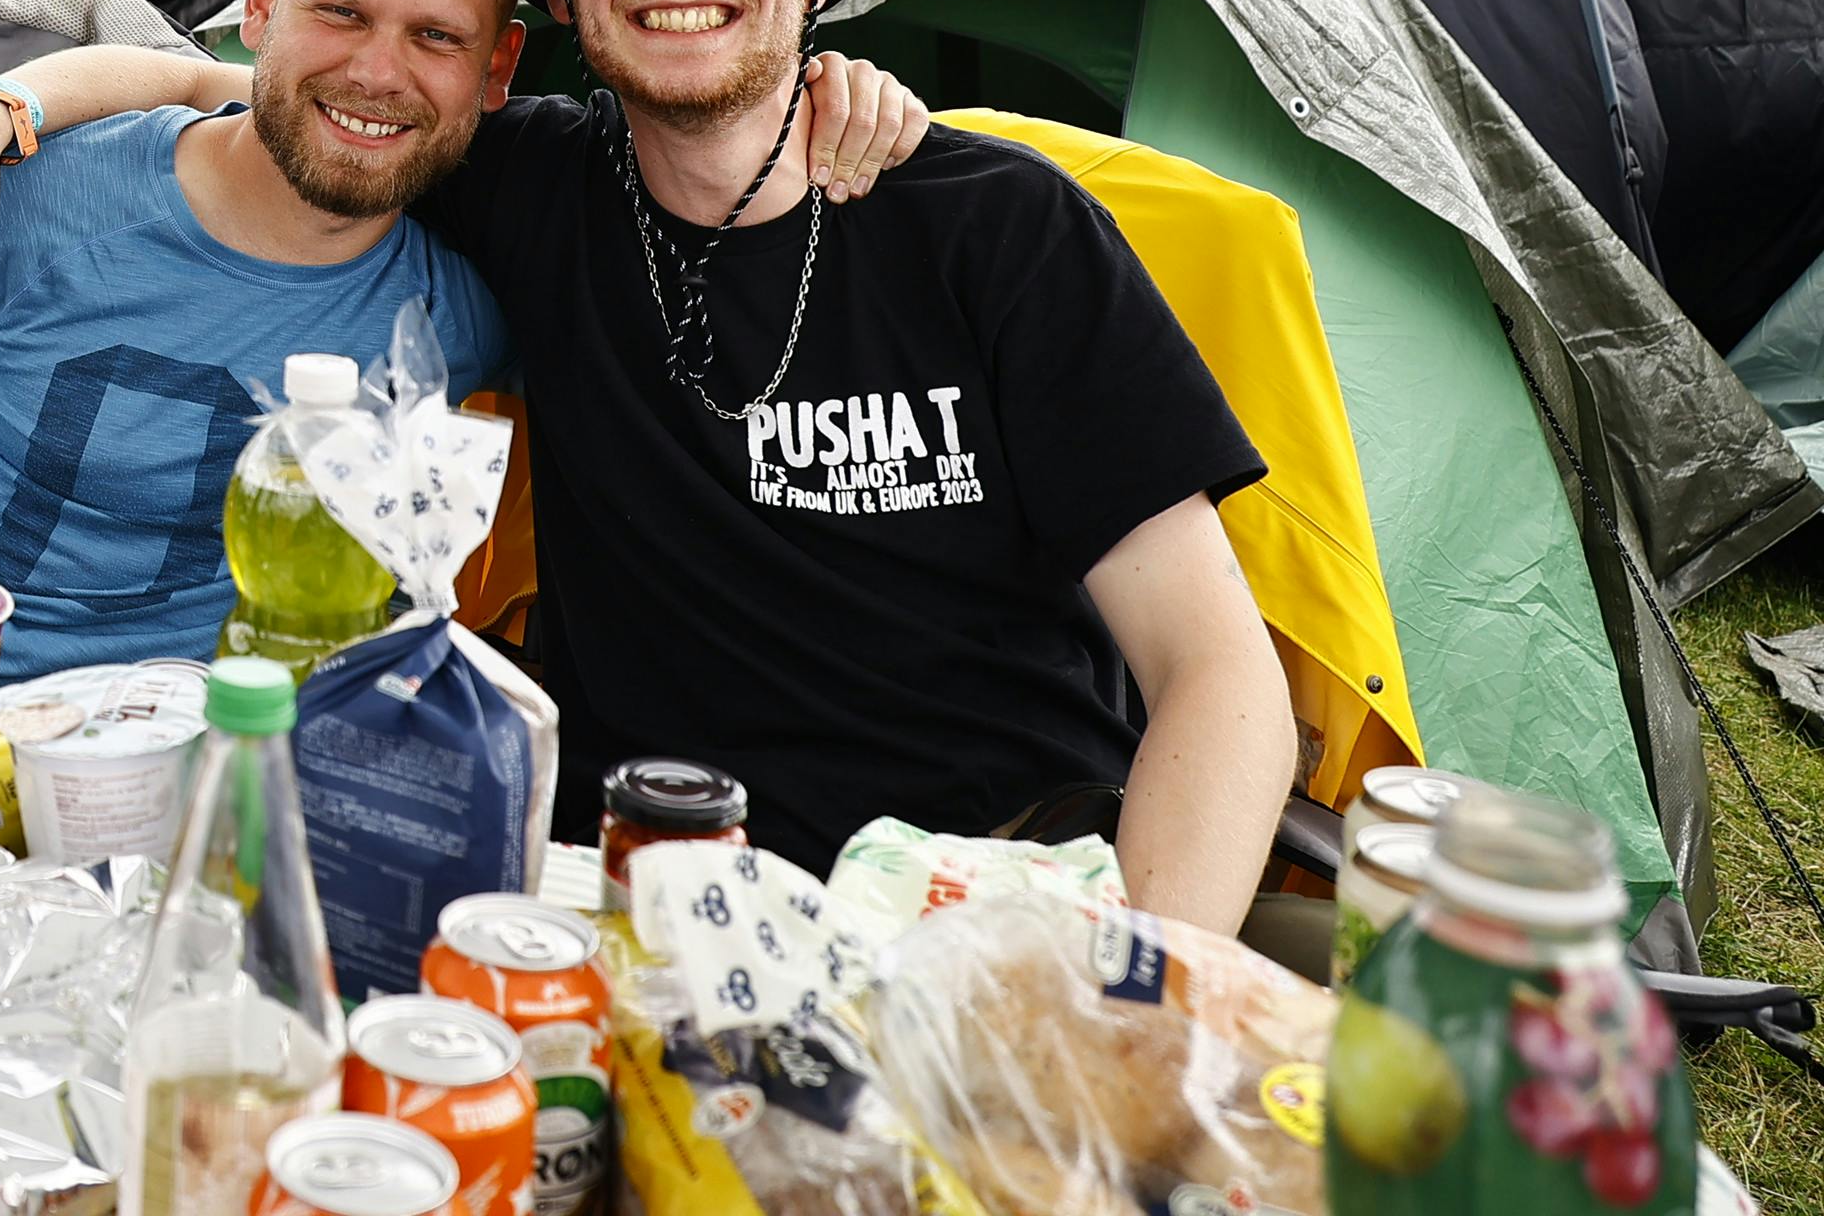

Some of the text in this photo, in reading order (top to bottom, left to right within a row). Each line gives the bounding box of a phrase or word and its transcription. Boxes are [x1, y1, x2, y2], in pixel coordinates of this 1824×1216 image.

[746, 386, 961, 468] PUSHA T
[750, 452, 976, 492] IT'S ALMOST DRY
[750, 479, 984, 515] LIVE FROM UK & EUROPE 2023
